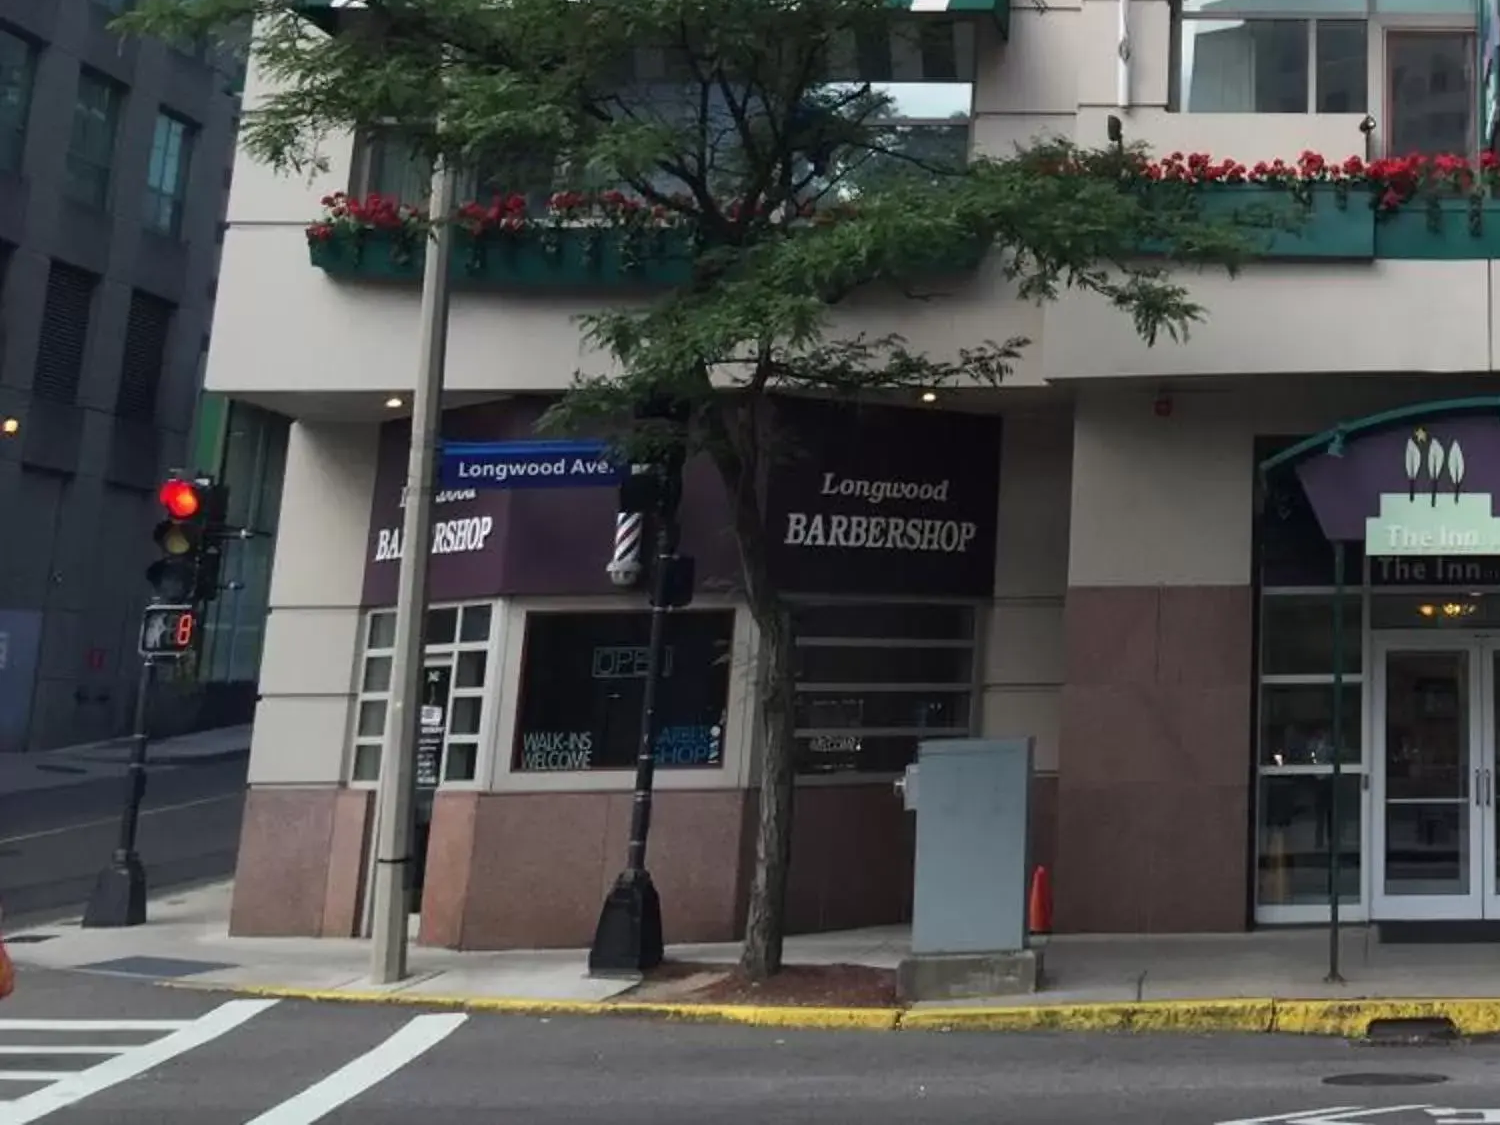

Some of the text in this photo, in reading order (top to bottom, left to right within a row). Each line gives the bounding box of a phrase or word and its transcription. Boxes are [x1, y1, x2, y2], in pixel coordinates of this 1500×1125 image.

[458, 458, 614, 480] Longwood Ave.
[820, 472, 950, 504] Longwood
[375, 516, 492, 561] BARSHOP
[784, 512, 977, 552] BARBERSHOP
[1387, 525, 1434, 549] The
[1441, 525, 1480, 549] Inn
[1378, 556, 1427, 581] The
[1437, 556, 1481, 581] Inn
[177, 613, 192, 645] 8
[524, 732, 592, 751] WALK-INS
[522, 751, 592, 770] WELCOME
